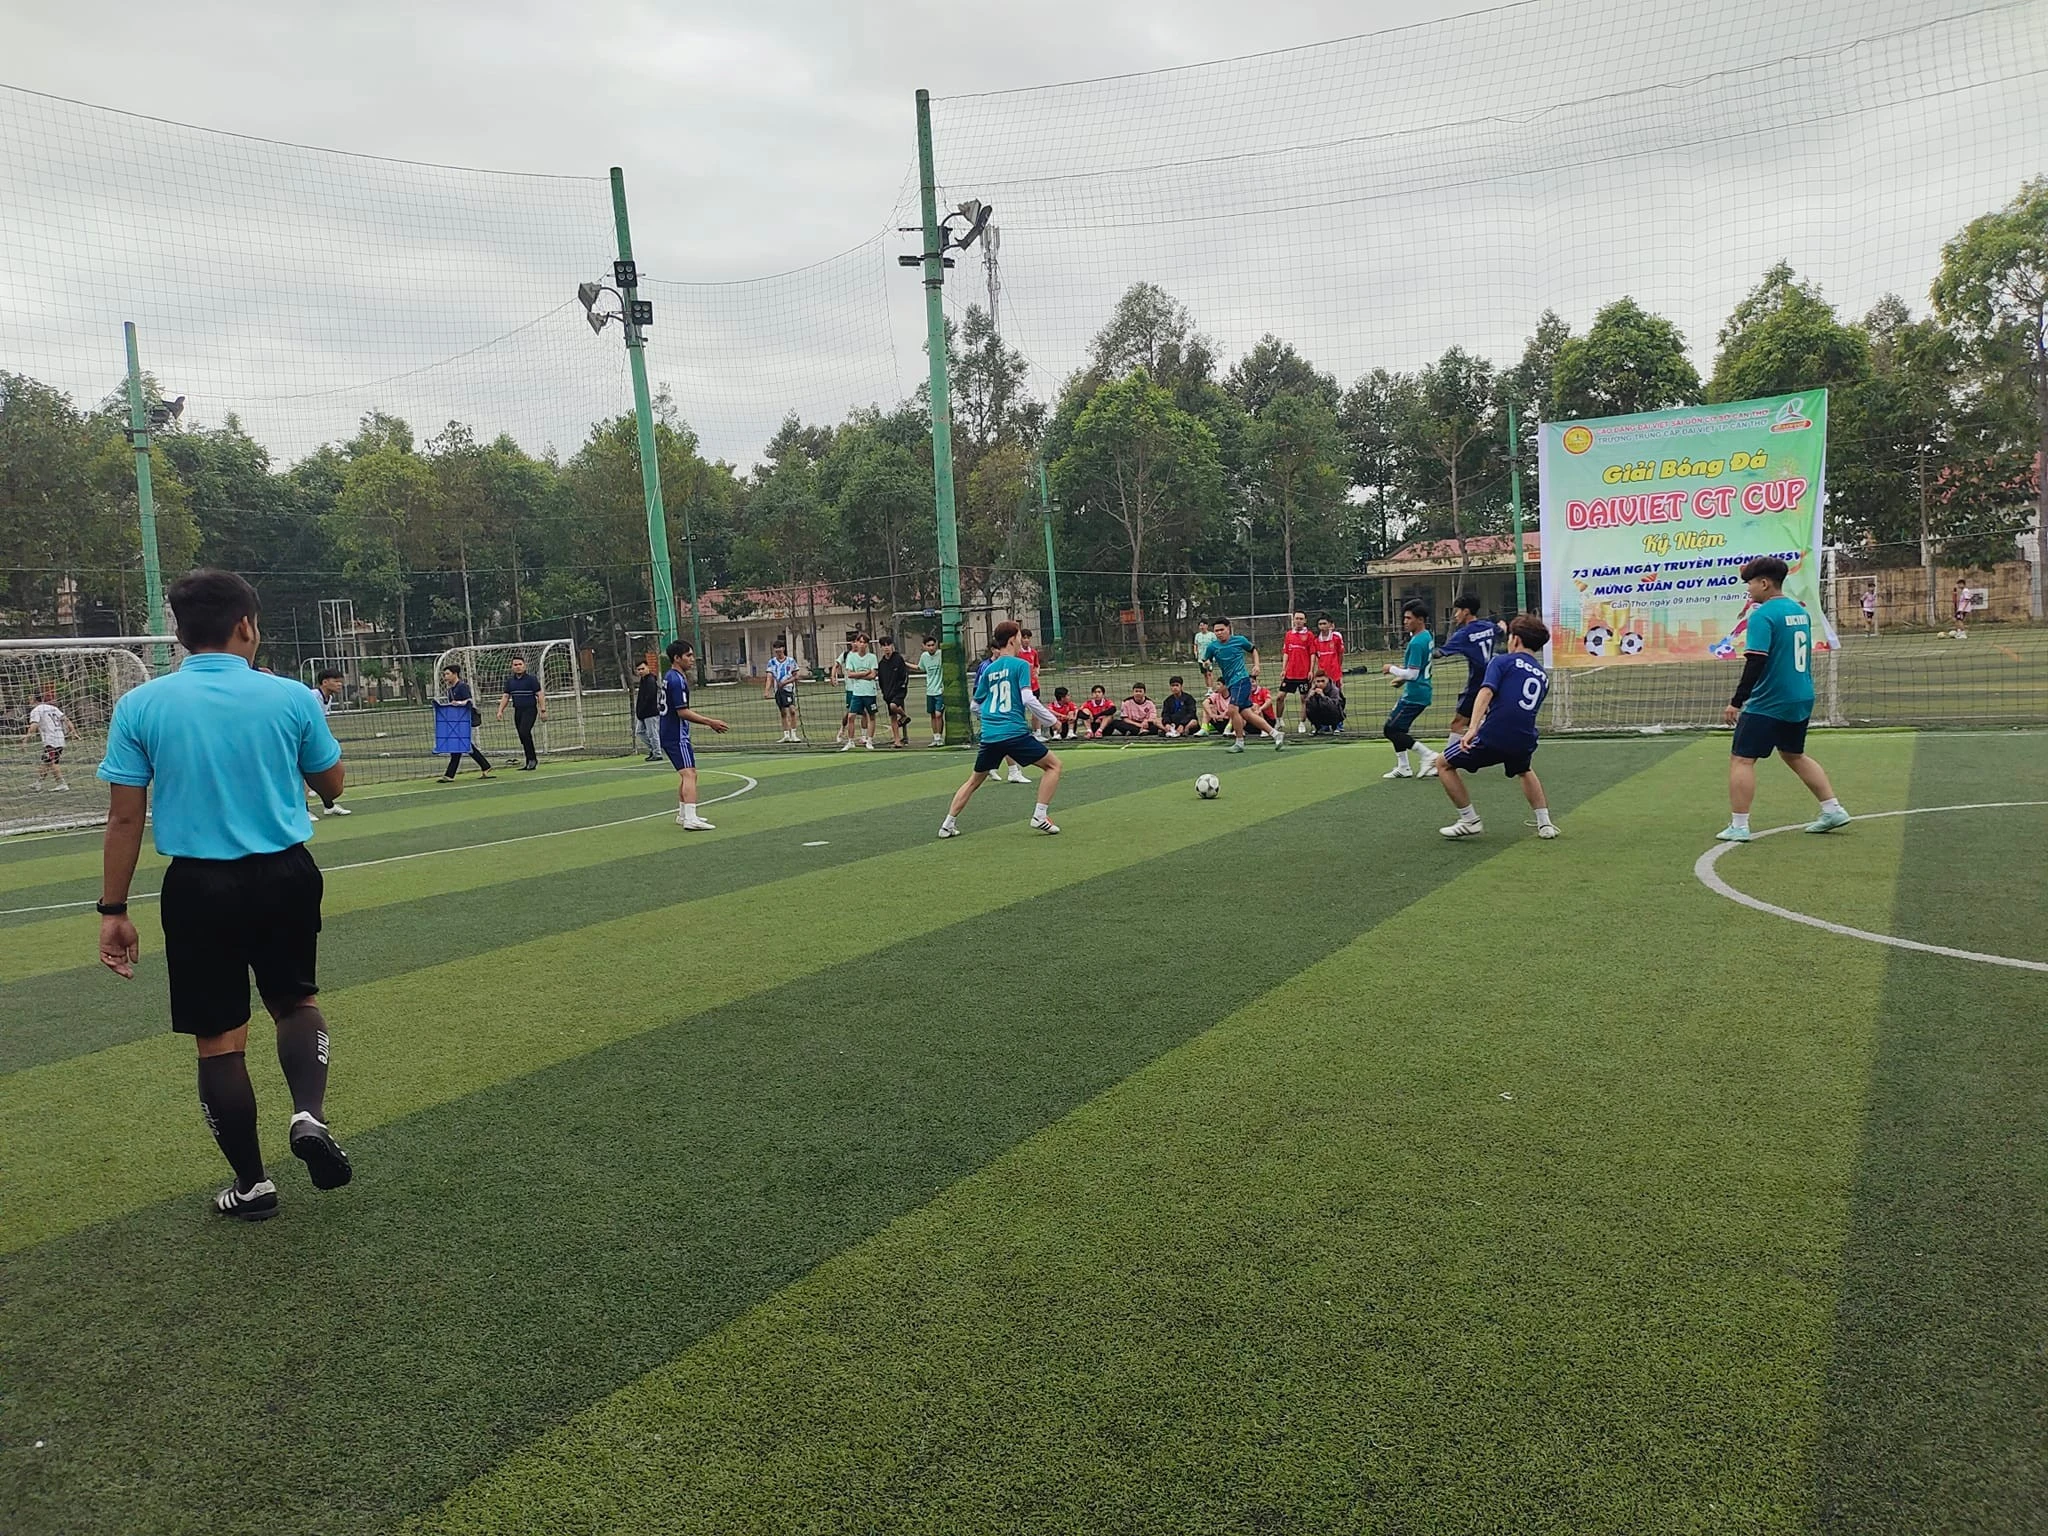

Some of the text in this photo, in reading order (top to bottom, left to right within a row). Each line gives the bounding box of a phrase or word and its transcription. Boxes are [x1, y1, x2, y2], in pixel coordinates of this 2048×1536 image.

[1602, 448, 1768, 484] Giải Bóng Đá
[1566, 477, 1807, 530] DAIVIET CT CUP
[1673, 529, 1727, 551] Niệm
[1572, 569, 1588, 579] 73
[1592, 564, 1620, 578] NĂM
[1624, 562, 1661, 575] NGÀY
[1636, 580, 1673, 593] XUÂN
[1676, 575, 1704, 590] QUÝ
[1673, 597, 1684, 605] 09
[1794, 630, 1807, 673] 6
[1518, 677, 1542, 711] 9
[317, 1030, 330, 1065] mitre
